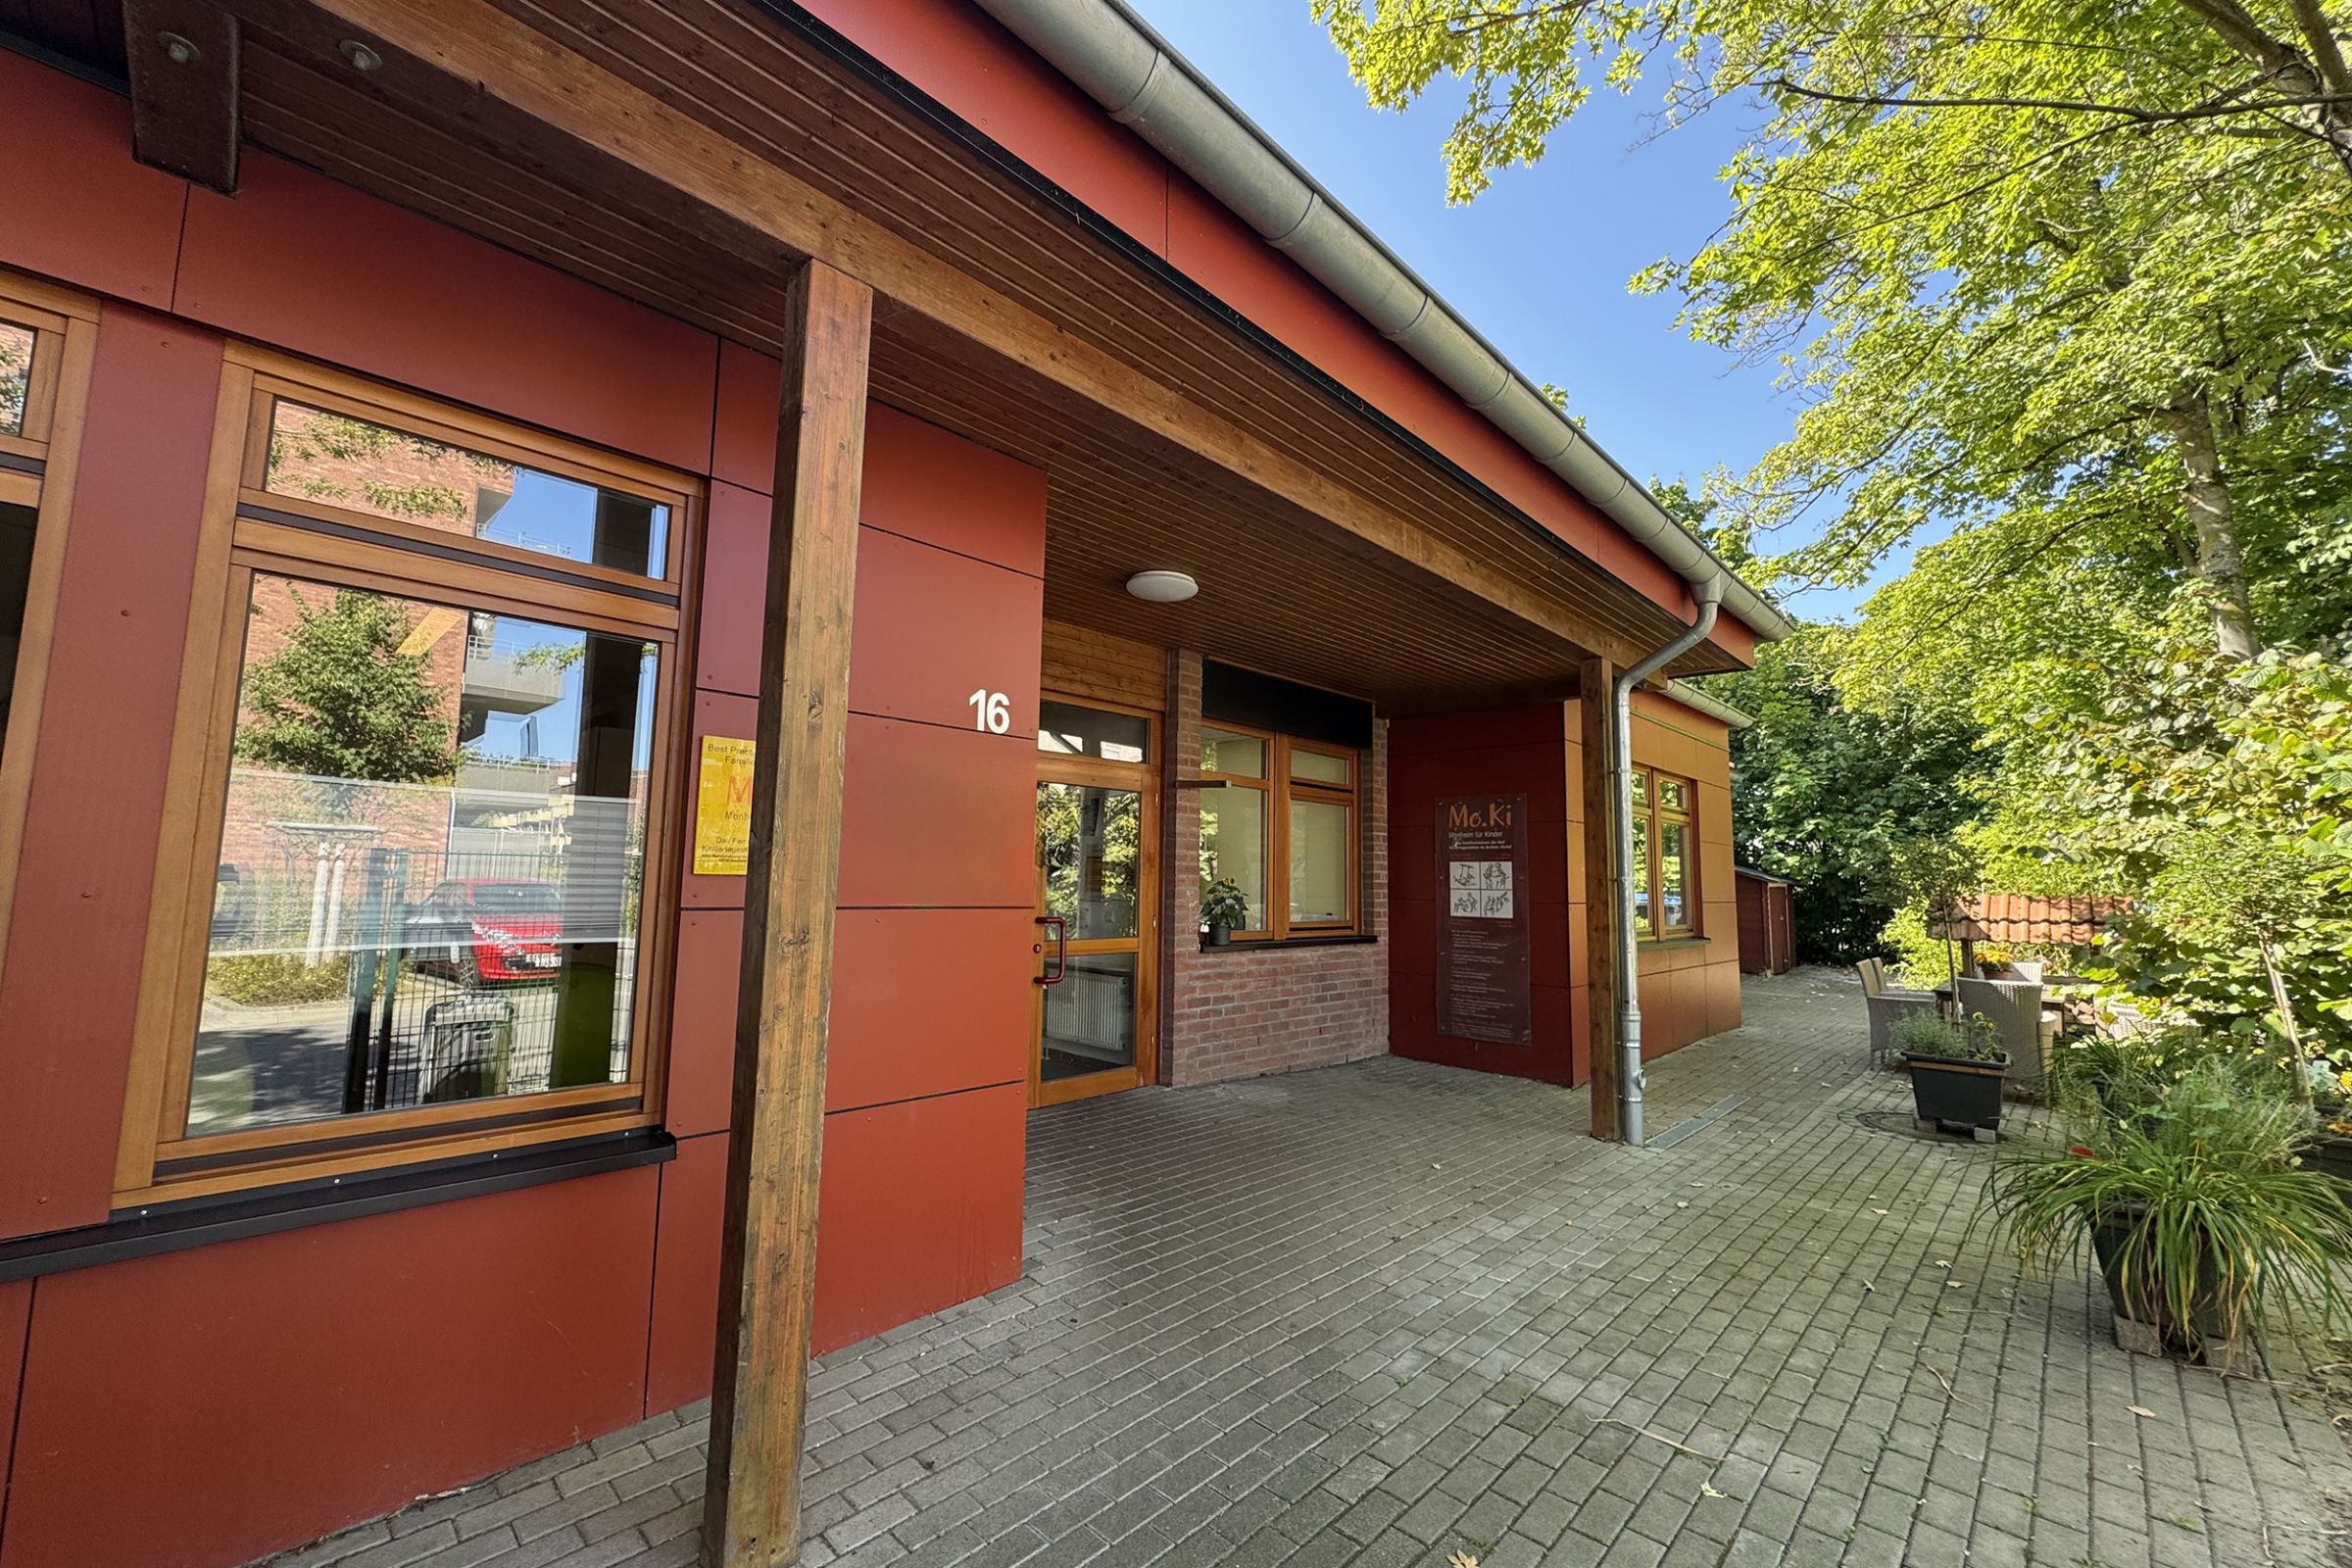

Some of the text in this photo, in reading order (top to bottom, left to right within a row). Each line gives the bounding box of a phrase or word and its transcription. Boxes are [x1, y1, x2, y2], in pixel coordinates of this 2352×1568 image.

[968, 688, 1010, 734] 16
[708, 743, 728, 754] Best
[724, 810, 750, 821] Monh
[1449, 803, 1512, 829] Mo.Ki
